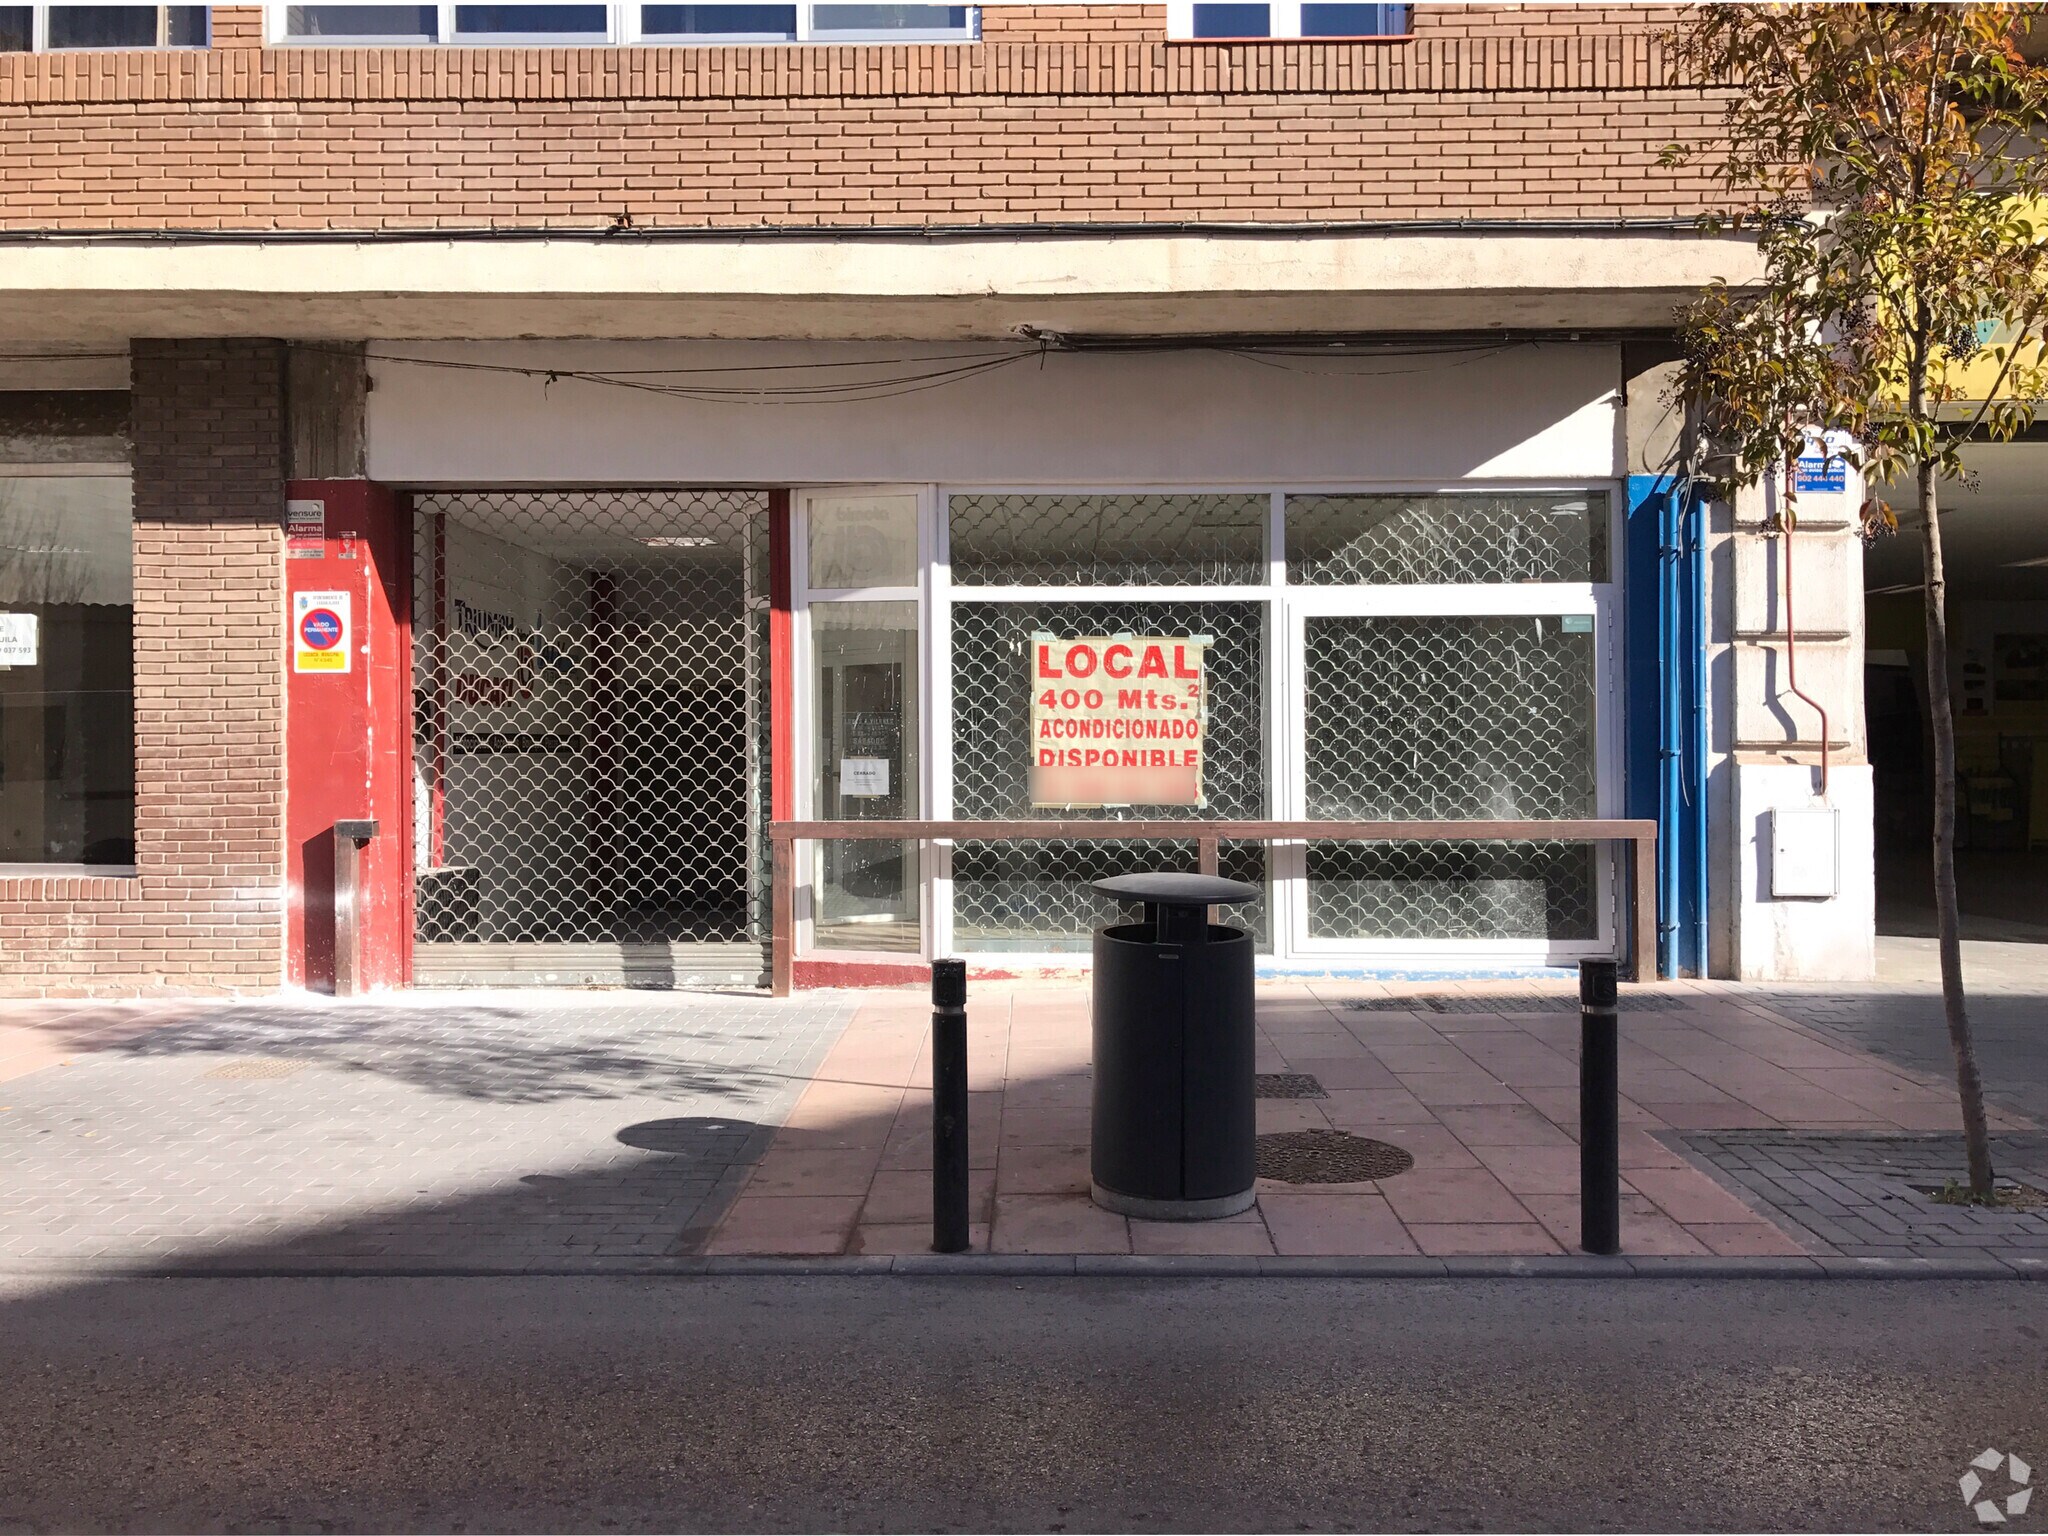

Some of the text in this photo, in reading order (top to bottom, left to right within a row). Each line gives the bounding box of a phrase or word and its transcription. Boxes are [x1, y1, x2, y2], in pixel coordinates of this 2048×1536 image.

[288, 524, 322, 532] Alarma
[454, 599, 514, 644] TRIUMPH
[1038, 644, 1199, 679] LOCAL
[1039, 689, 1103, 710] 400
[1039, 718, 1199, 739] ACONDICIONADO
[1039, 748, 1198, 767] DISPONIBLE
